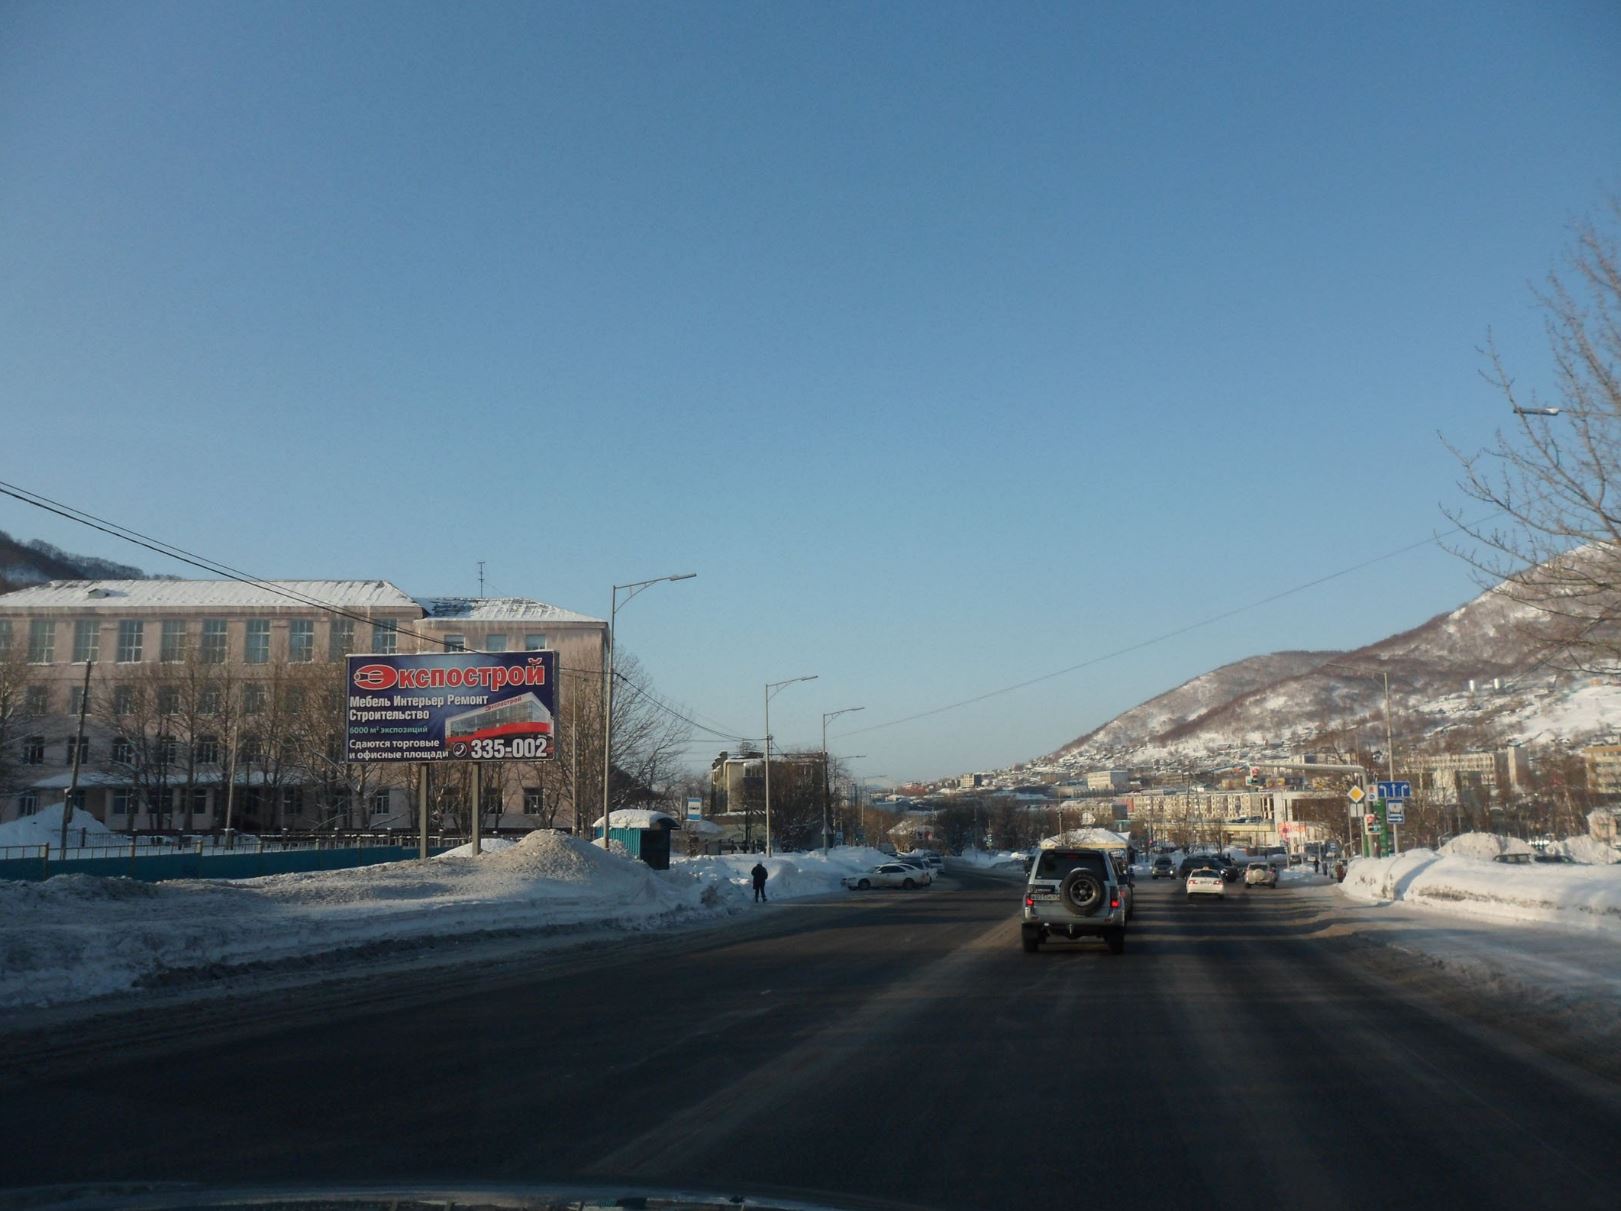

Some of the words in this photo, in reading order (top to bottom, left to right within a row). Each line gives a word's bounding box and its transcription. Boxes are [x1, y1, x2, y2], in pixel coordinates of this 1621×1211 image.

[353, 657, 545, 691] Экспострой
[349, 695, 391, 708] Мебель
[393, 695, 444, 708] Интерьер
[447, 694, 488, 706] Ремонт
[349, 709, 430, 722] Строительство
[349, 726, 369, 734] 6000
[380, 725, 428, 735] экспозиций
[349, 739, 391, 749] Сдаются
[392, 739, 440, 749] торговые
[470, 738, 547, 759] 335-002
[357, 750, 402, 760] офисные
[403, 750, 449, 759] площади
